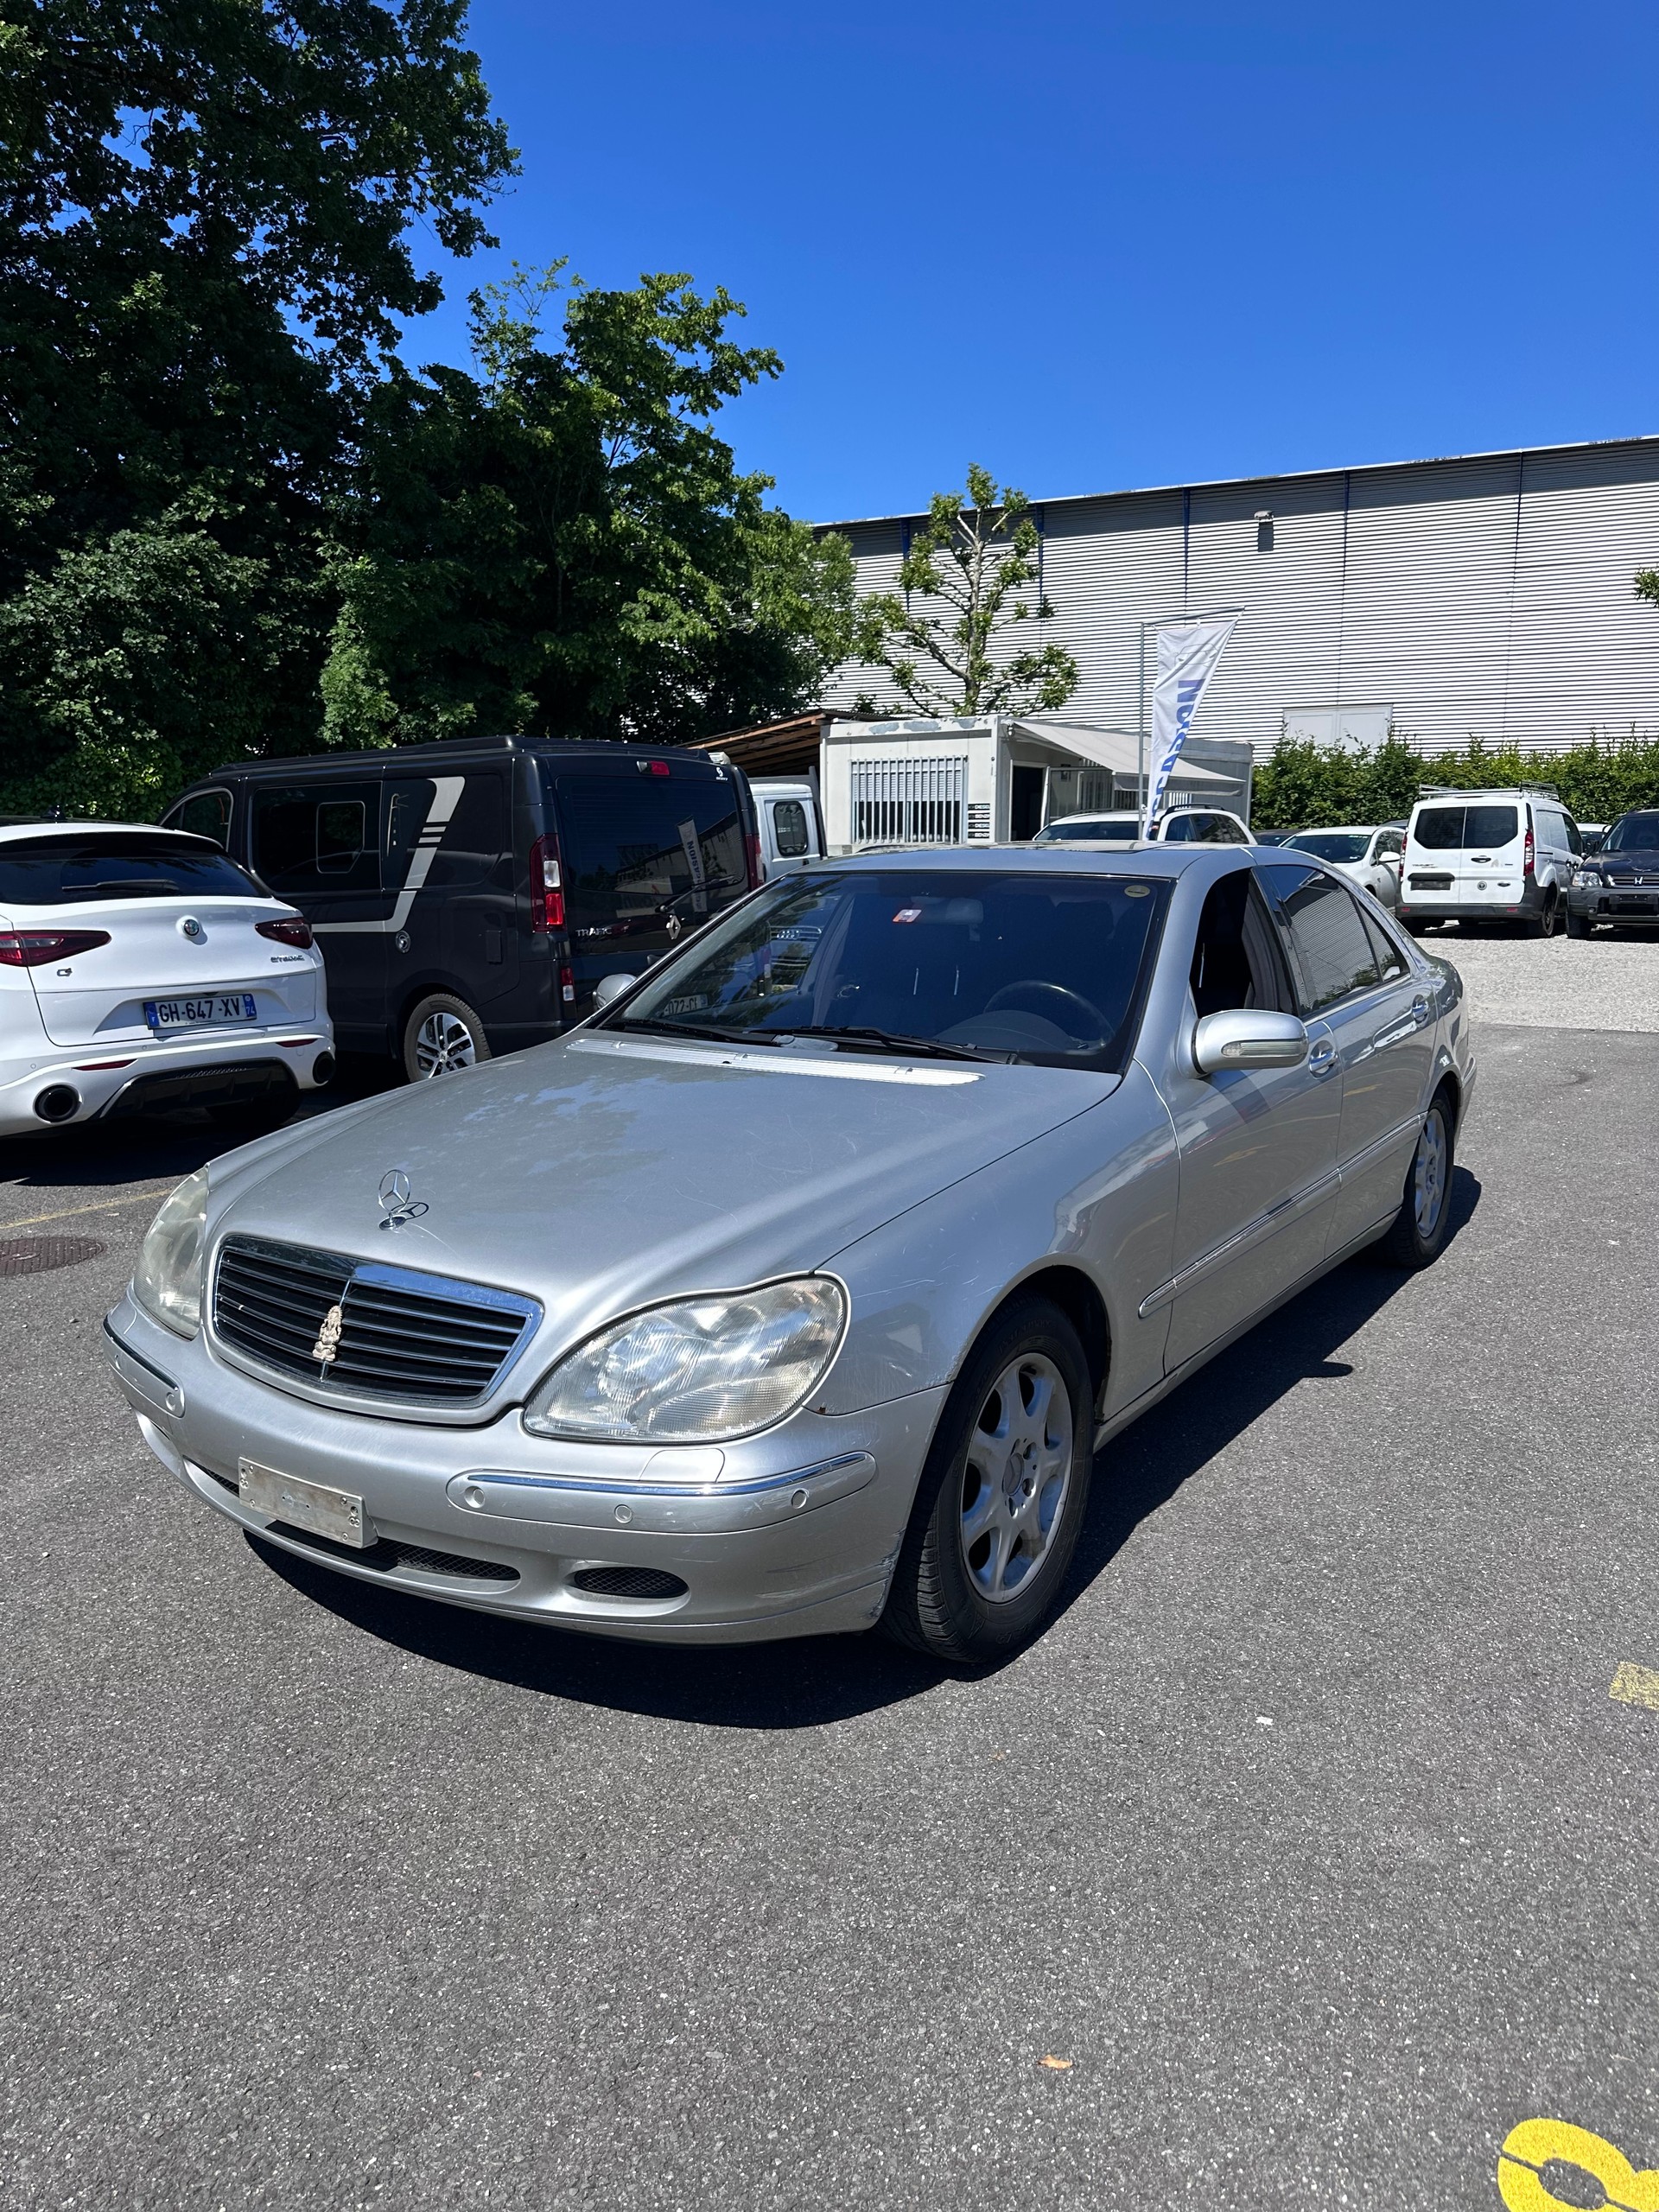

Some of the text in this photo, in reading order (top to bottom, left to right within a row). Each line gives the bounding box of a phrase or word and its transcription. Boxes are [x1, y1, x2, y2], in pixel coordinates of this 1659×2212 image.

[575, 927, 613, 937] TRAFIC
[158, 997, 240, 1022] GH-647-XV
[246, 1006, 256, 1015] 74
